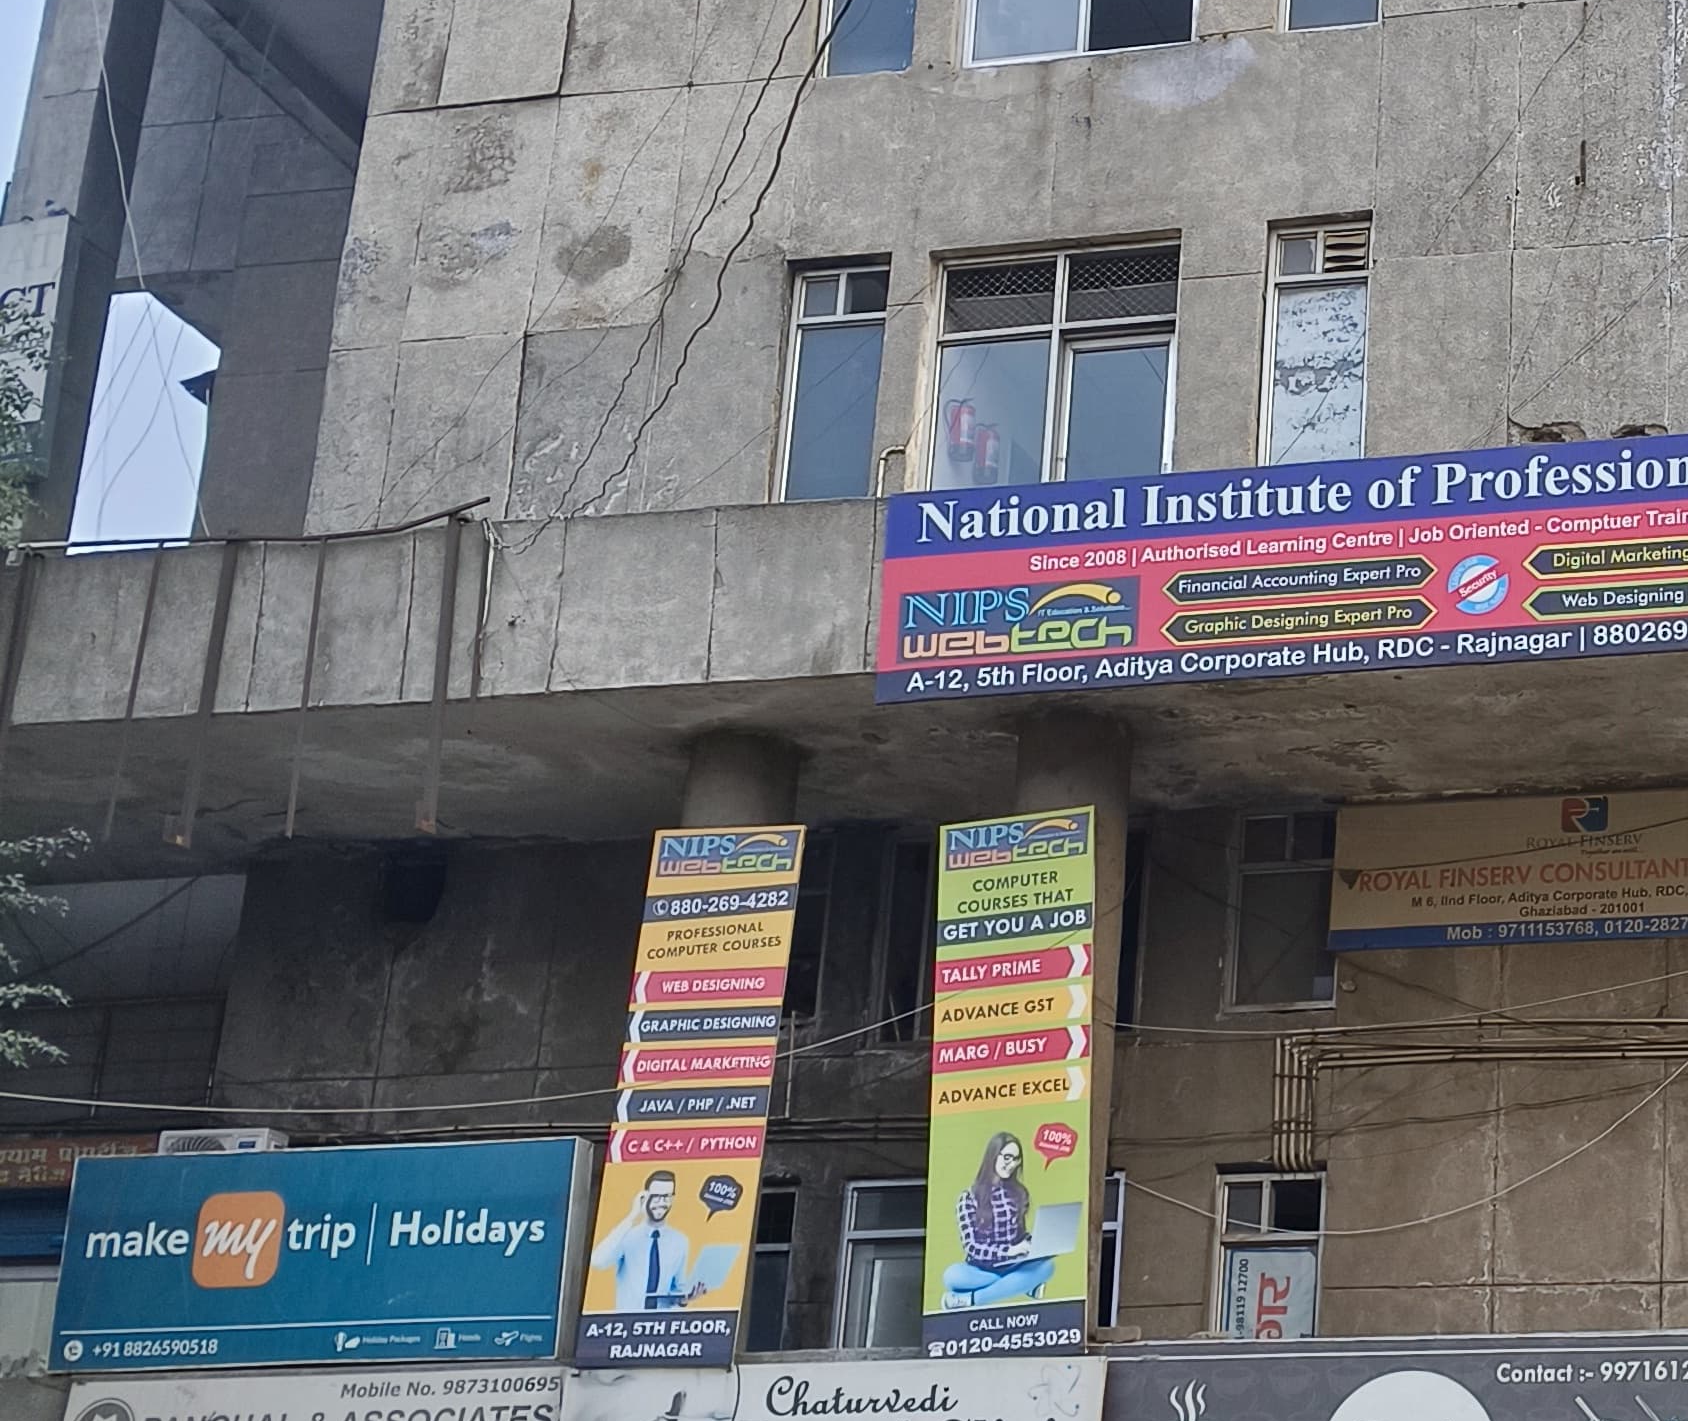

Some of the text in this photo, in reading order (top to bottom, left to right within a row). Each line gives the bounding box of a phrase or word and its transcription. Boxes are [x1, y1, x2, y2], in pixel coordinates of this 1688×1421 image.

[916, 486, 1127, 544] National
[1140, 478, 1352, 526] Institute
[1368, 461, 1424, 507] of
[1029, 553, 1080, 573] Since
[1084, 547, 1127, 568] 2008
[1140, 540, 1241, 564] Authorised
[1246, 532, 1329, 560] Learning
[1333, 529, 1393, 550] Centre
[1408, 524, 1445, 544] Job
[1449, 519, 1530, 541] Oriented
[1547, 511, 1640, 538] Comptuer
[1178, 563, 1422, 594] Financial Accounting Expert Pro
[1457, 569, 1499, 599] Security
[904, 586, 1031, 629] NIPS
[1562, 592, 1598, 608] Web
[1603, 586, 1685, 607] Designing
[906, 670, 970, 695] A-12,
[976, 666, 1015, 687] 5th
[1021, 661, 1089, 687] Floor,
[1096, 653, 1174, 683] Aditya
[1180, 646, 1306, 676] Corporate
[1313, 641, 1370, 668] Hub,
[1378, 638, 1435, 661] RDC
[1457, 629, 1573, 659] Rajnagar
[973, 870, 1059, 893] COMPUTER
[1359, 870, 1433, 893] ROYAL
[1438, 865, 1534, 888] FINSERV
[670, 890, 789, 916] 880-269-4282
[957, 888, 1075, 914] COURSES THAT
[1519, 902, 1645, 918] Ghaziabad 201001
[666, 922, 764, 943] PROFESSIONAL
[943, 910, 1087, 941] GET YOU A JOB
[1447, 926, 1482, 940] Mob
[1498, 921, 1599, 938] 9711153768,
[646, 935, 782, 960] COMPUTER COURSES
[942, 958, 1041, 984] TALLY PRIME
[661, 976, 766, 994] WEB DESIGNING
[639, 1095, 756, 1113] JAVA PHP .NET
[85, 1209, 546, 1280] make my trip Holidays
[586, 1319, 732, 1339] A-12, 5TH FLOOR,
[969, 1312, 1039, 1332] CALL NOW
[609, 1341, 702, 1358] RAJNAGAR
[945, 1327, 1082, 1357] 0120-4553029
[1496, 1362, 1574, 1383] Contact
[340, 1377, 560, 1398] Mobile No. 9873100695
[766, 1376, 958, 1417] Chaturvedi
